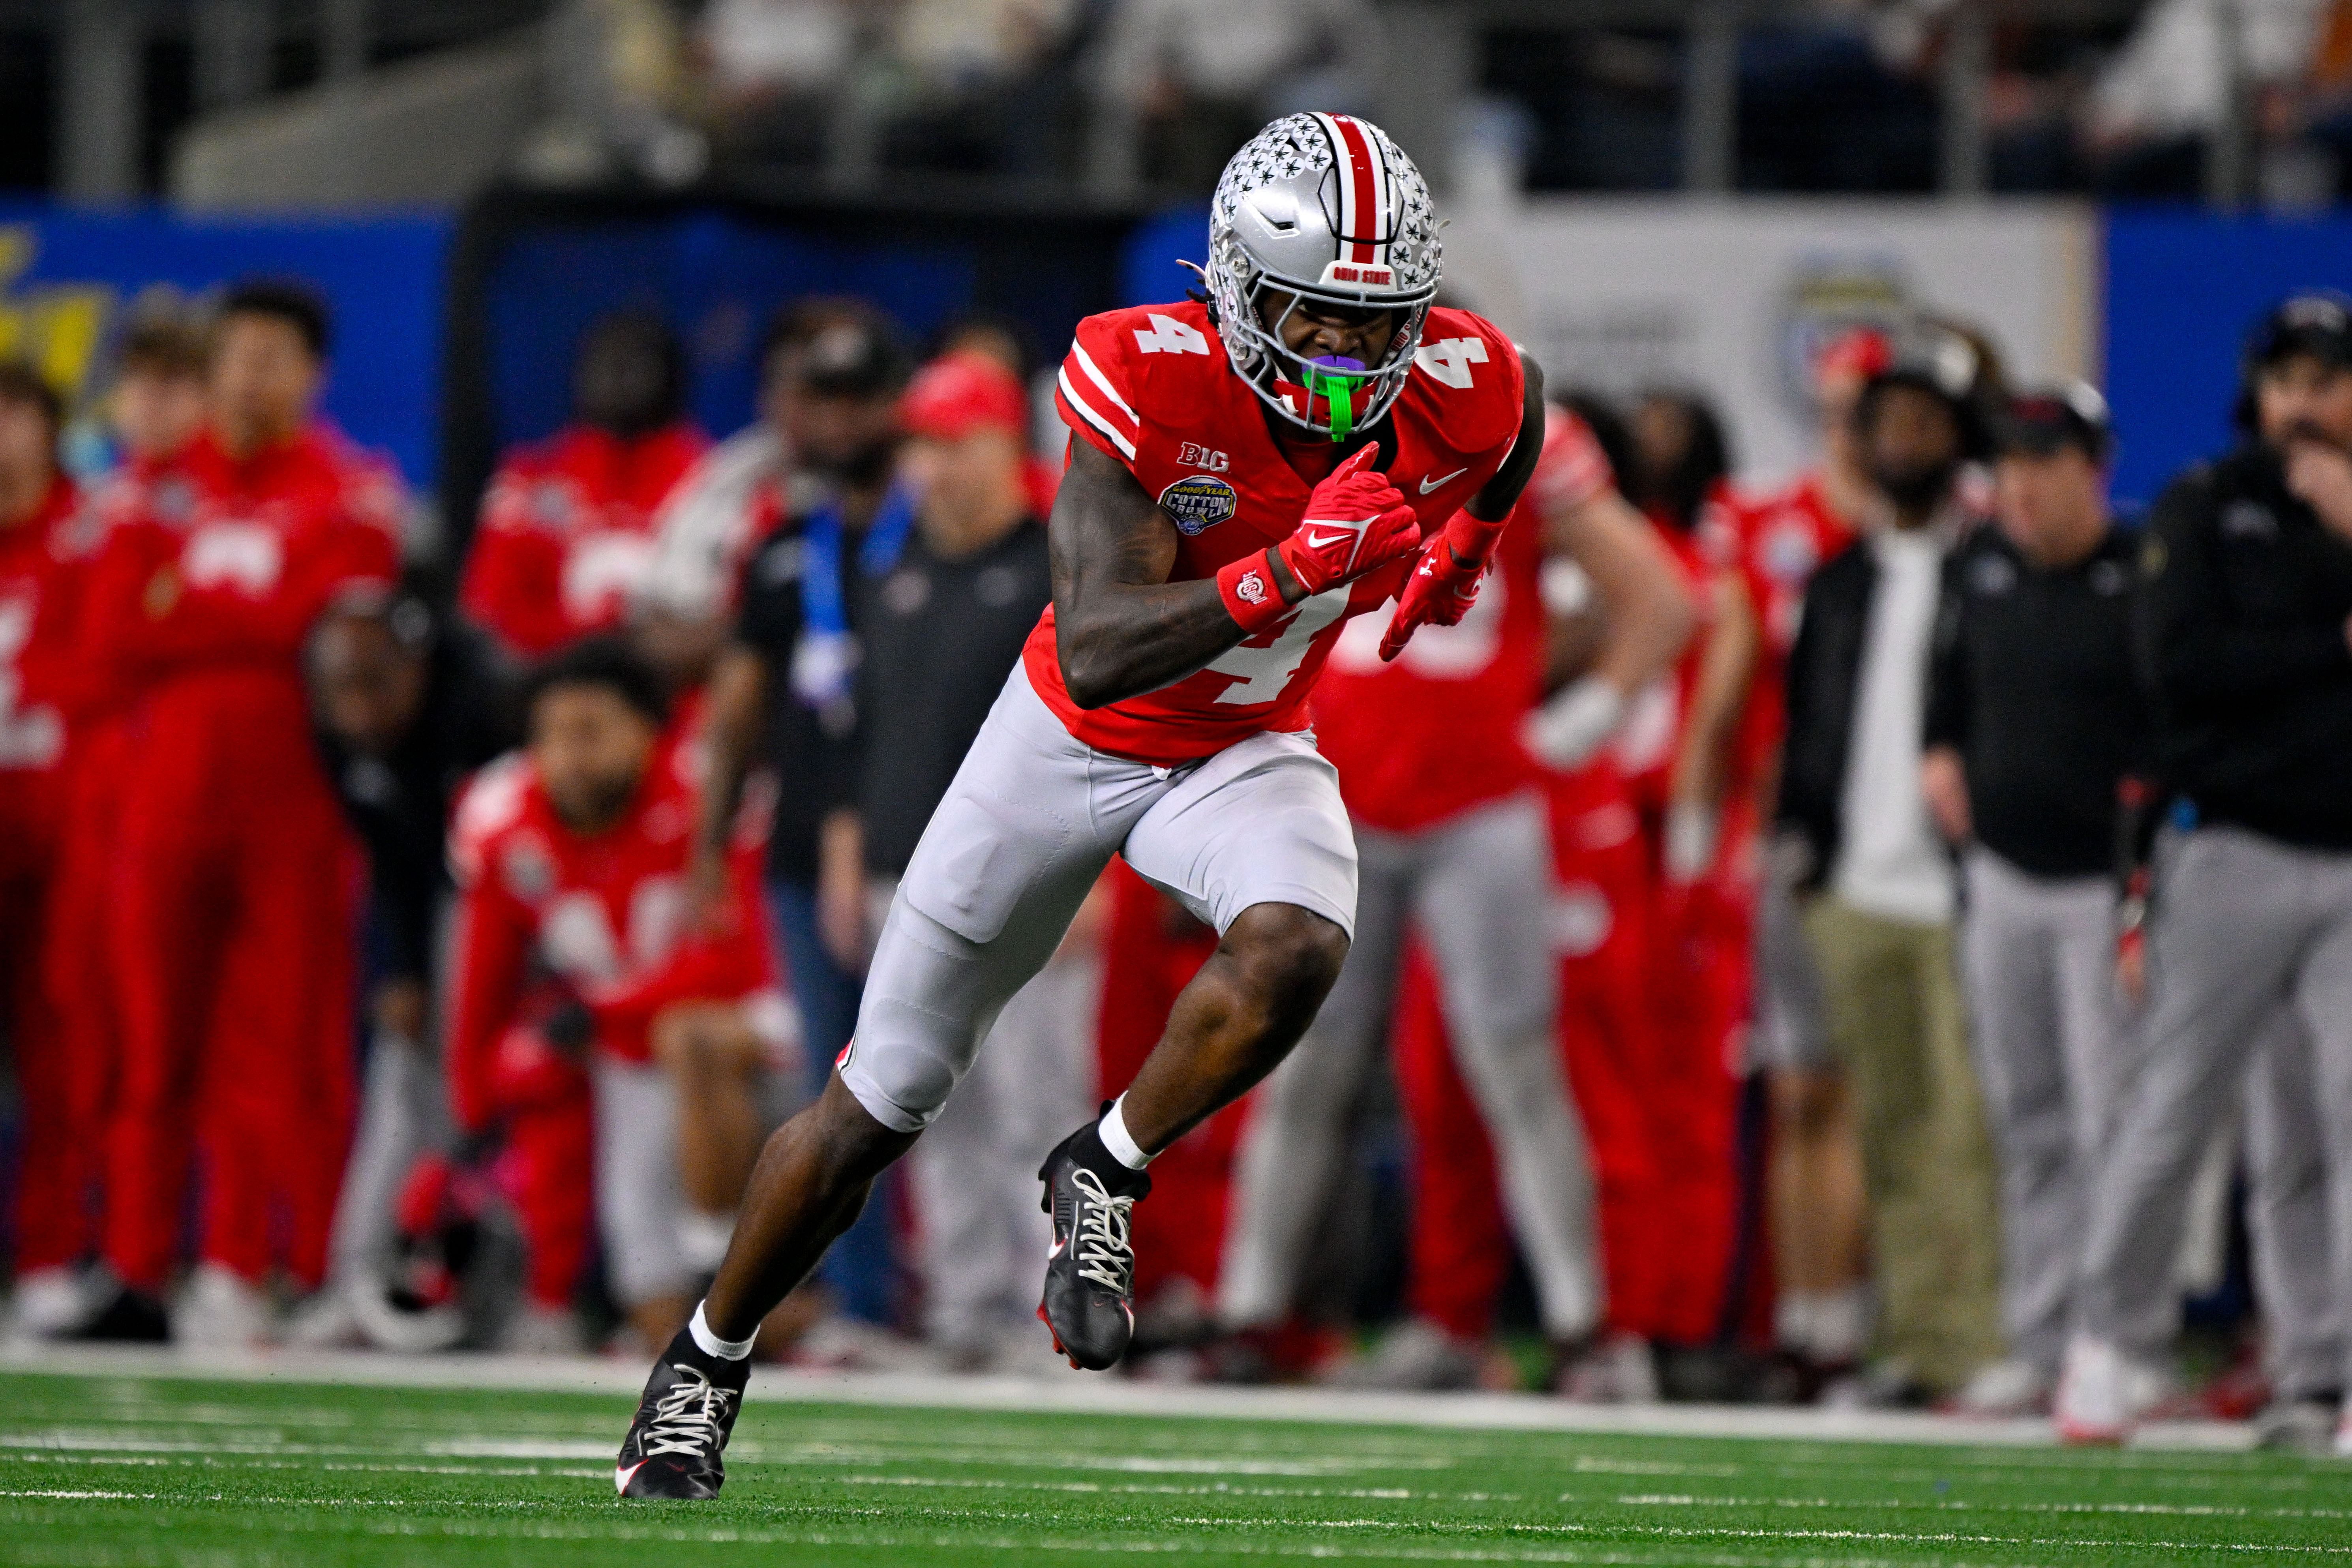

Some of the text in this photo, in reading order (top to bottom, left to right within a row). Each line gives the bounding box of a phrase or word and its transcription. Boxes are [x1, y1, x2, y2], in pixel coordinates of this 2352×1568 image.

[1334, 266, 1391, 285] OHIO STATE
[1133, 313, 1210, 355] 4
[1412, 337, 1489, 389] 4
[1166, 493, 1230, 516] COTTON
[1176, 505, 1216, 519] BOWL
[1204, 581, 1353, 705] 4
